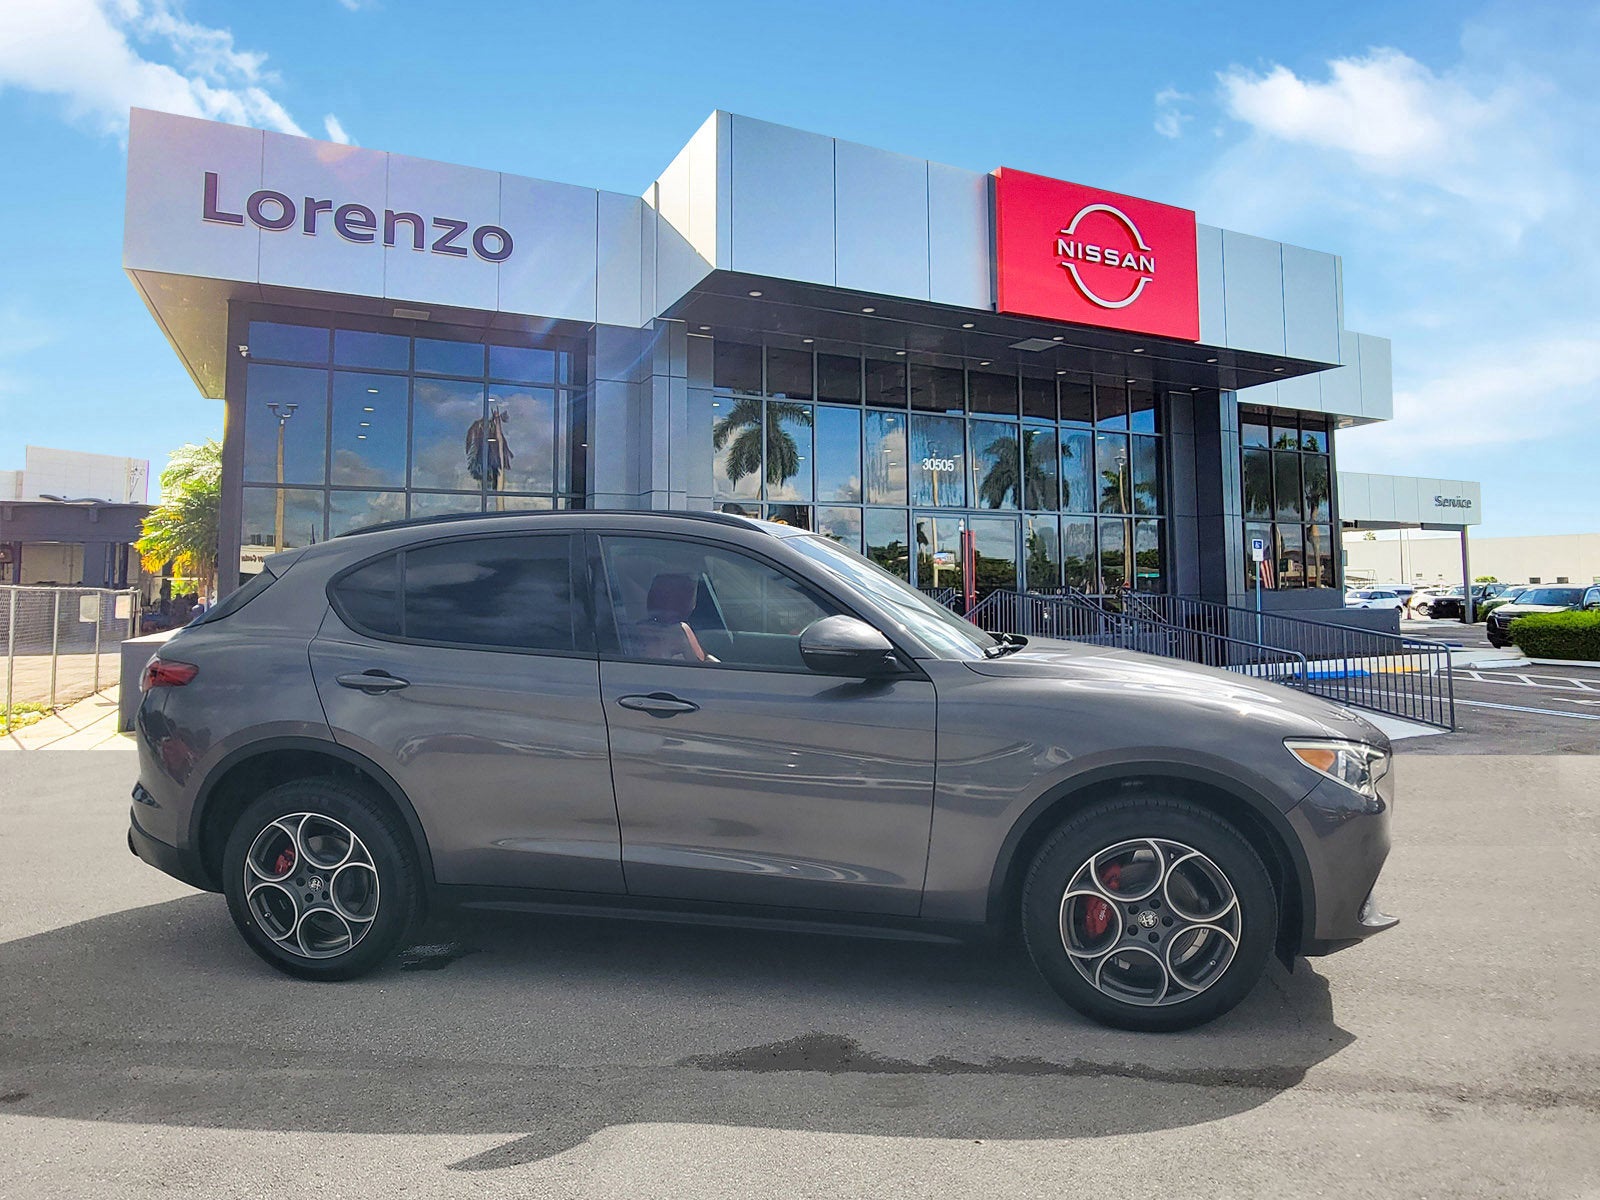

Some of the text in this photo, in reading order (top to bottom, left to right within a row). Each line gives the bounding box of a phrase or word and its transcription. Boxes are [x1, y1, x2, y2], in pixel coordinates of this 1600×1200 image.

[202, 171, 514, 262] Lorenzo
[1057, 238, 1155, 273] NISSAN
[922, 457, 955, 472] 30505
[1434, 495, 1472, 508] Service
